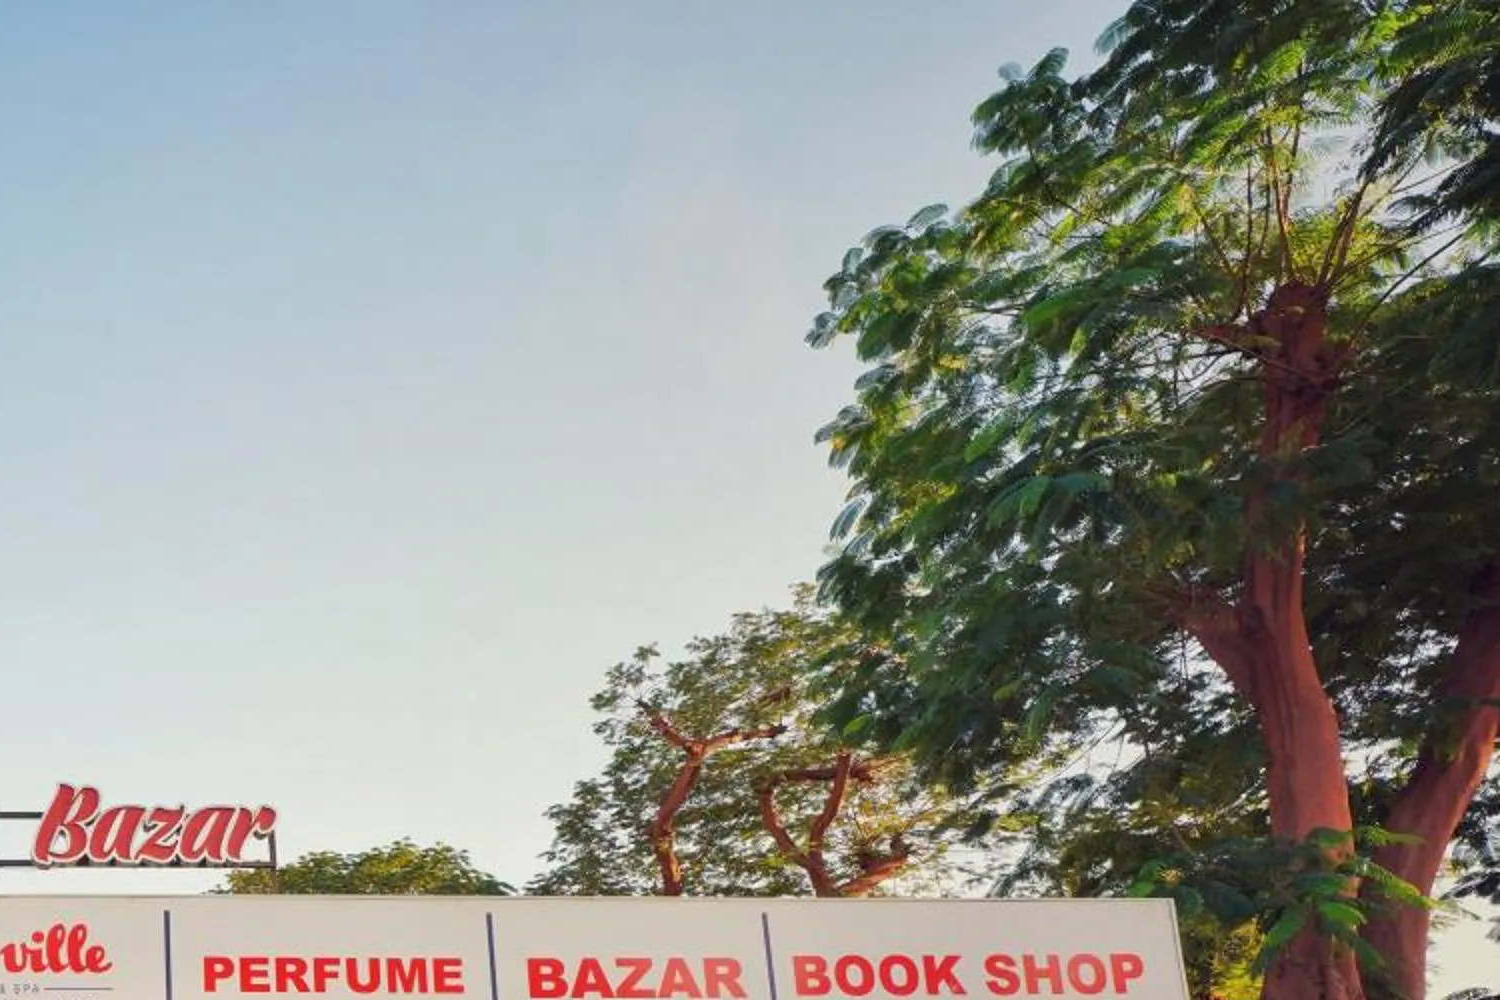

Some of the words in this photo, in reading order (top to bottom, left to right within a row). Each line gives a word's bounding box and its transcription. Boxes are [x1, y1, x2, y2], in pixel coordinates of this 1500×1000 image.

[32, 783, 277, 865] Bazar
[13, 984, 41, 995] SPA
[203, 955, 465, 994] PERFUME
[528, 957, 747, 999] BAZAR
[792, 953, 967, 997] BOOK
[984, 953, 1145, 996] SHOP
